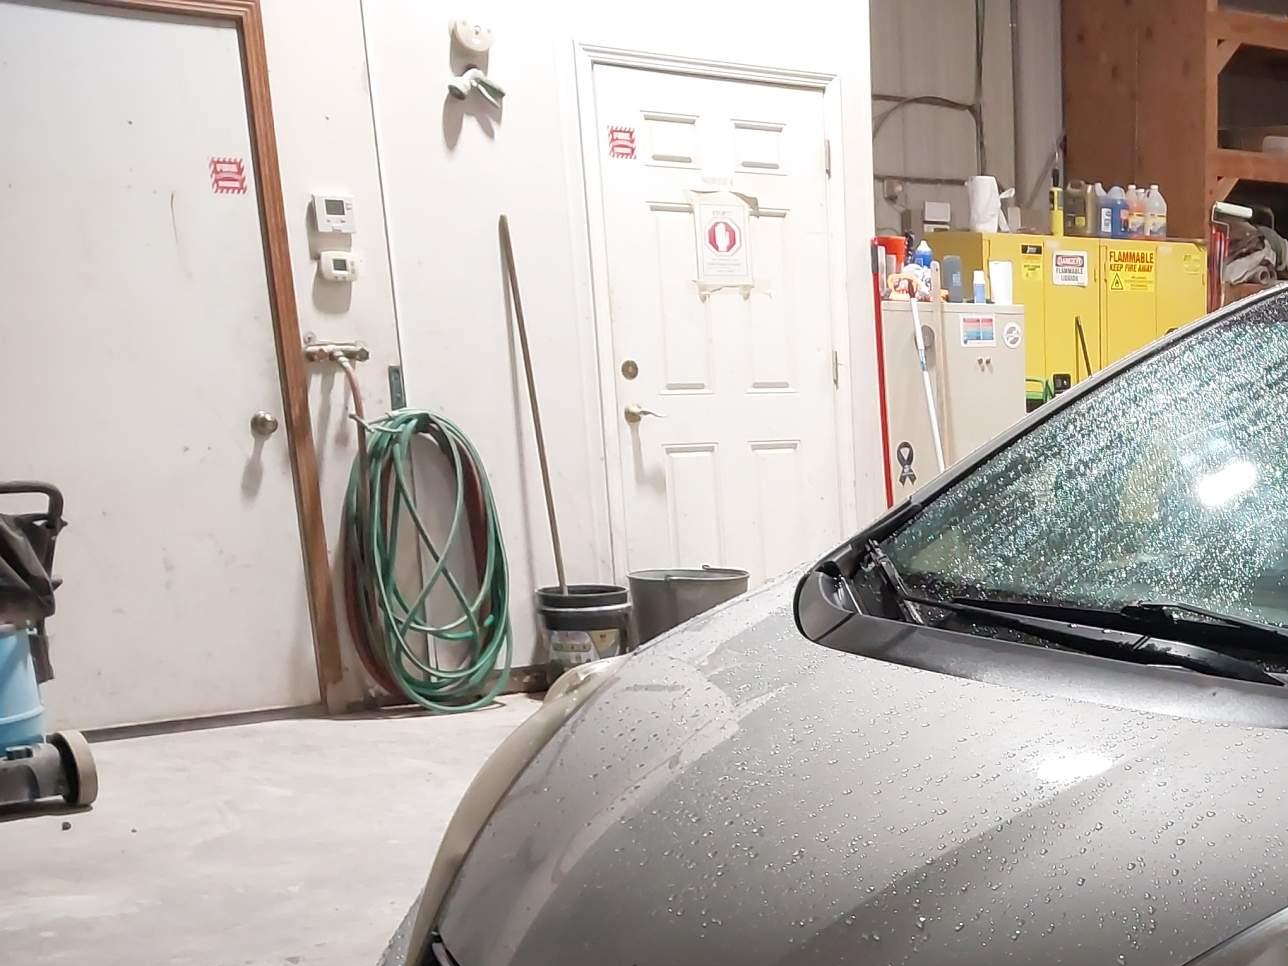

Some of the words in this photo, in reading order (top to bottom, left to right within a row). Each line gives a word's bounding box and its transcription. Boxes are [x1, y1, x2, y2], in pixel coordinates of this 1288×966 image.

[1109, 250, 1154, 263] FLAMMABLE
[1110, 263, 1123, 272] KEEP
[1125, 264, 1136, 272] FIRE
